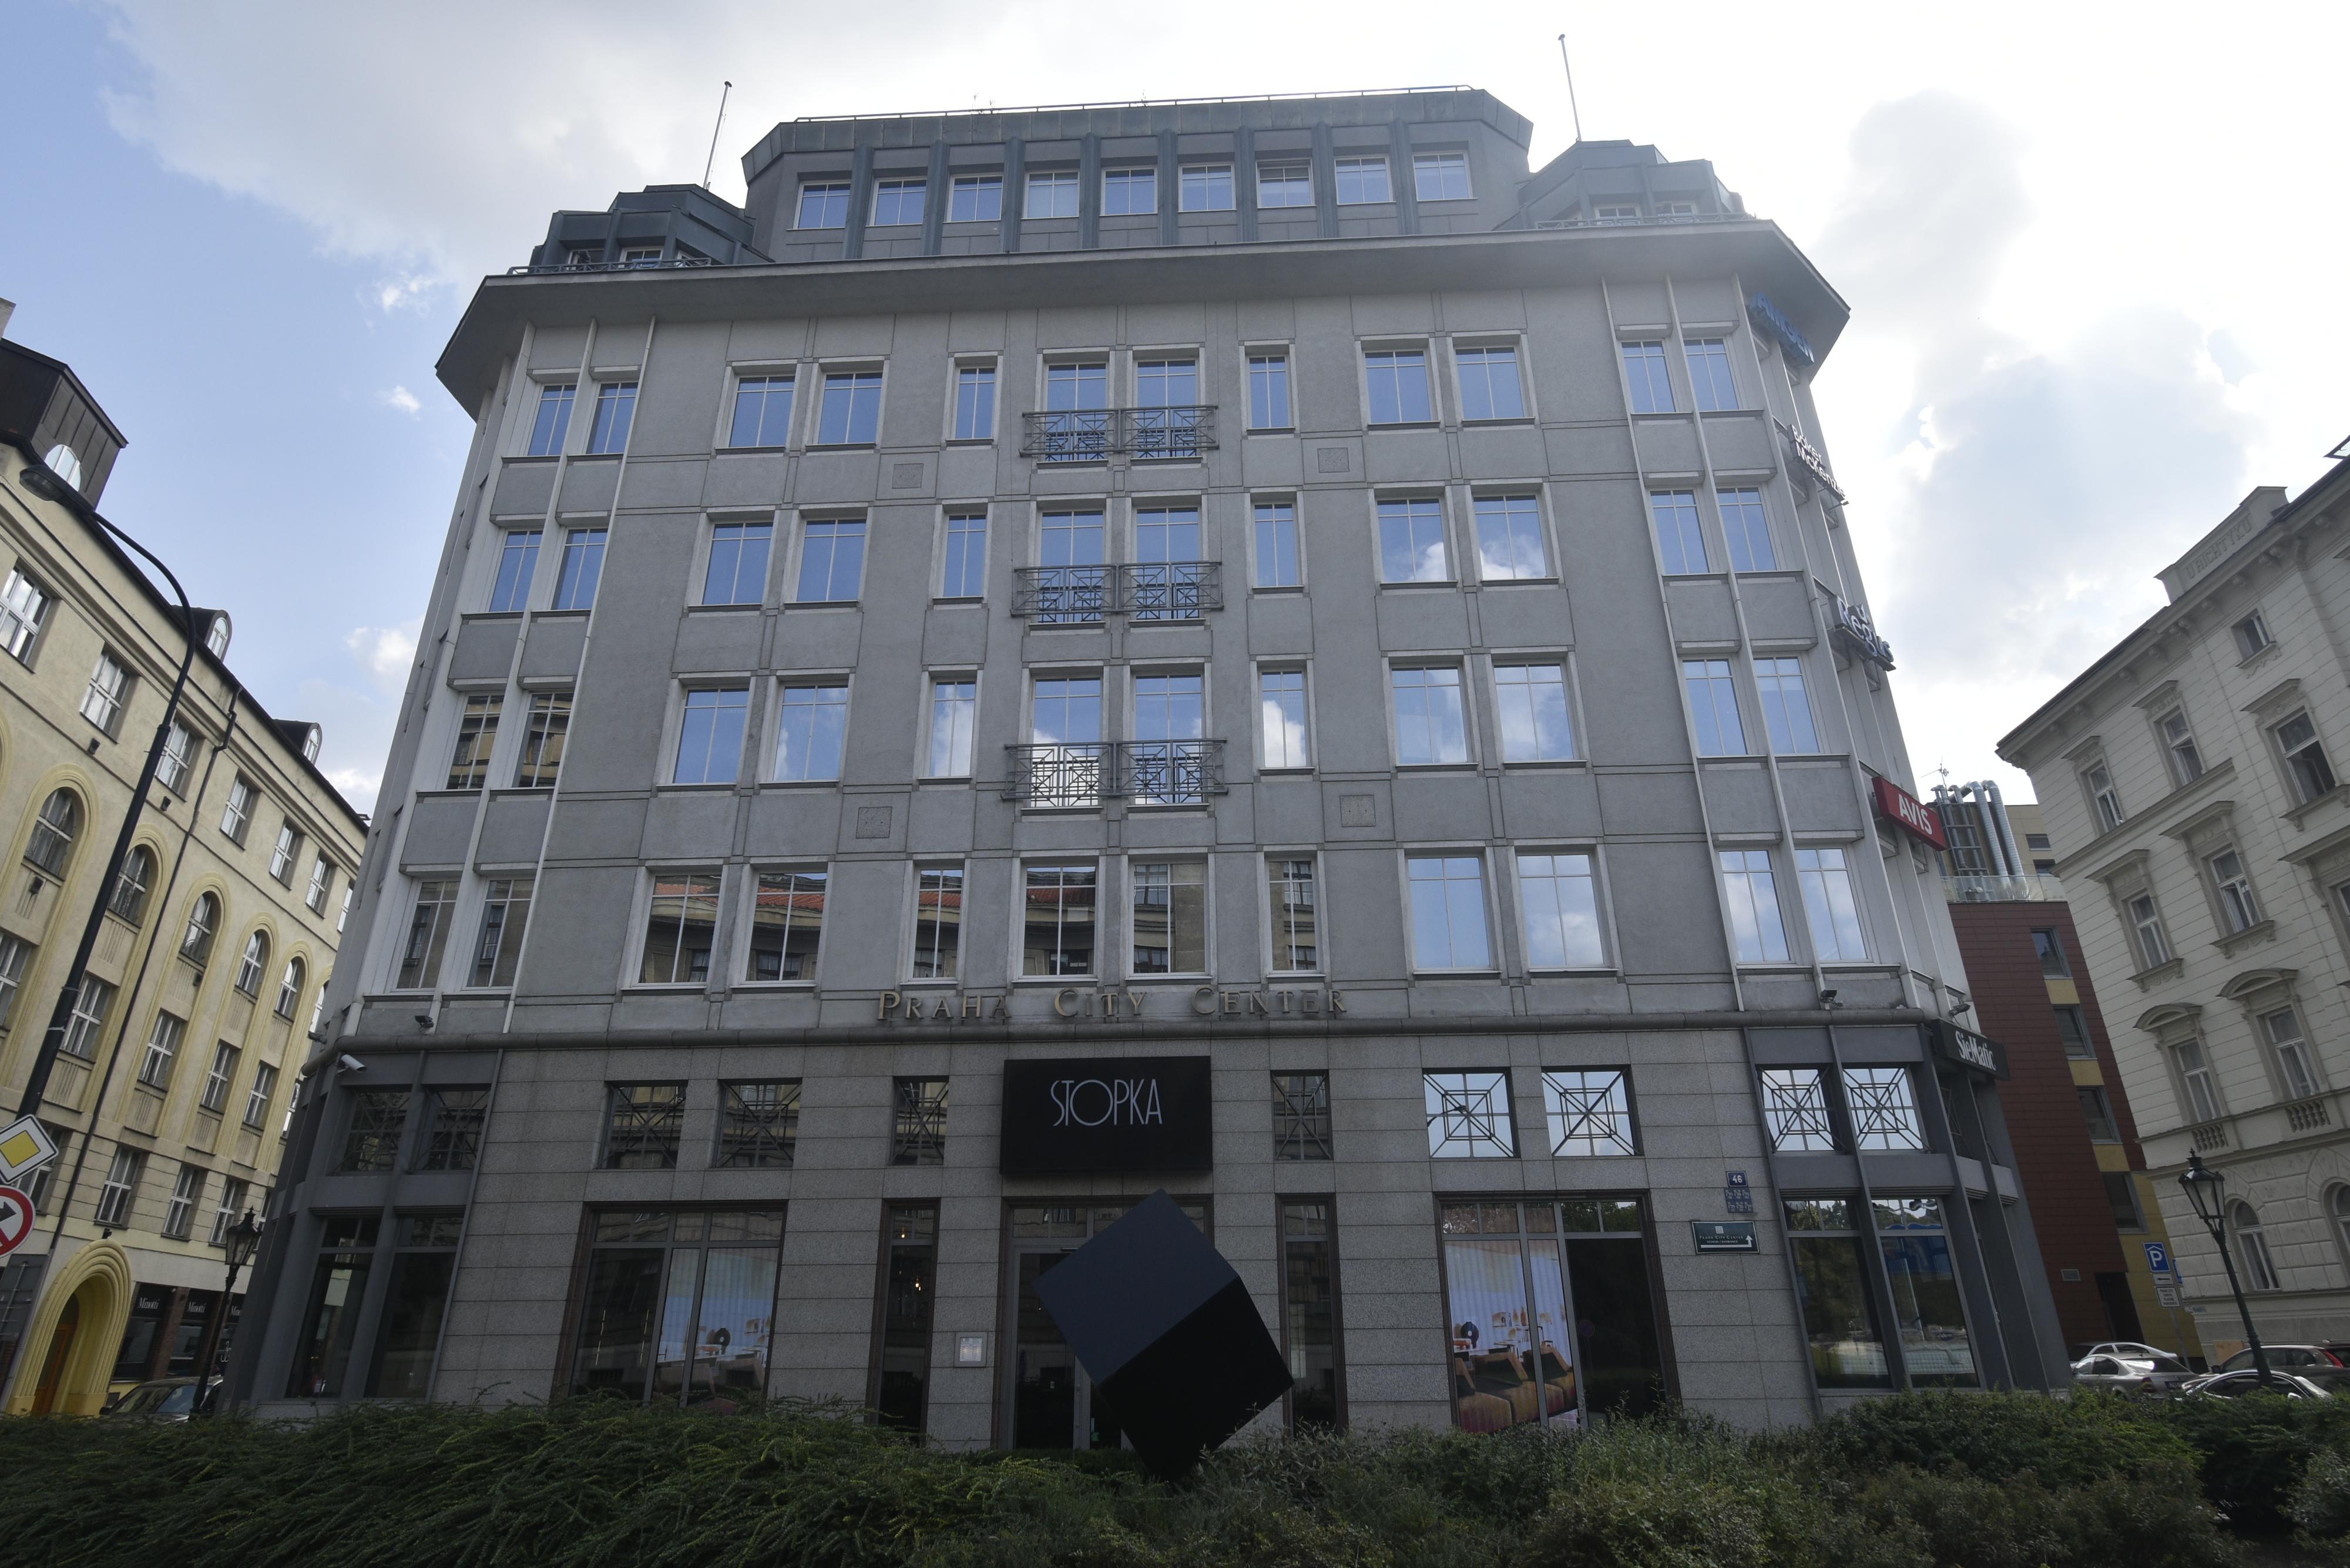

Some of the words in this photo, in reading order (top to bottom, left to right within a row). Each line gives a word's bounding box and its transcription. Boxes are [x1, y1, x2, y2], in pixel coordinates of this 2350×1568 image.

[1791, 424, 1822, 464] Baker
[1796, 442, 1845, 497] McKenzie
[1837, 595, 1894, 663] Regus
[1898, 794, 1932, 835] AVIS
[877, 991, 1012, 1020] PRAHA
[1055, 986, 1147, 1018] CITY
[1191, 985, 1347, 1015] CENTER
[1955, 1030, 1996, 1071] SieMatic
[1050, 1079, 1163, 1126] STOPKA
[1733, 1175, 1743, 1183] 46
[2149, 1250, 2162, 1267] P
[137, 1297, 160, 1310] Minotti
[187, 1301, 206, 1313] Minotti
